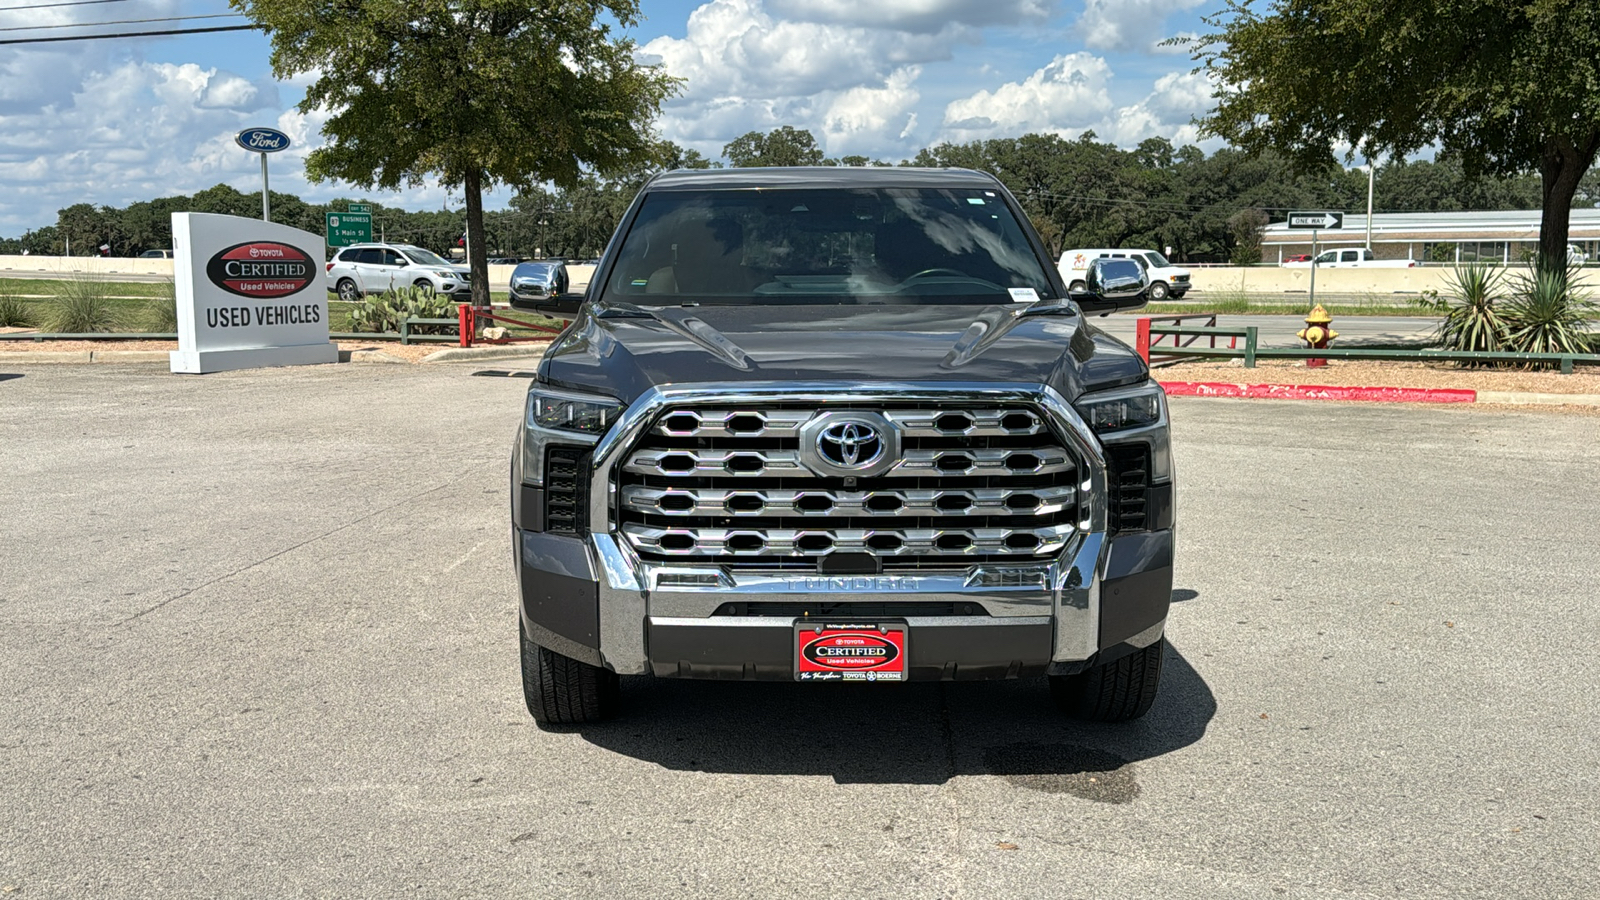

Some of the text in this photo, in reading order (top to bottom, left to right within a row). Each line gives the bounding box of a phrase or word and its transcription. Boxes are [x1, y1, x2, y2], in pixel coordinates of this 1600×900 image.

[250, 132, 280, 147] Ford
[259, 249, 284, 257] TOYOTA
[240, 282, 295, 291] Used Vehicles
[207, 304, 320, 328] USED VEHICLES
[783, 576, 919, 590] TUNDRA
